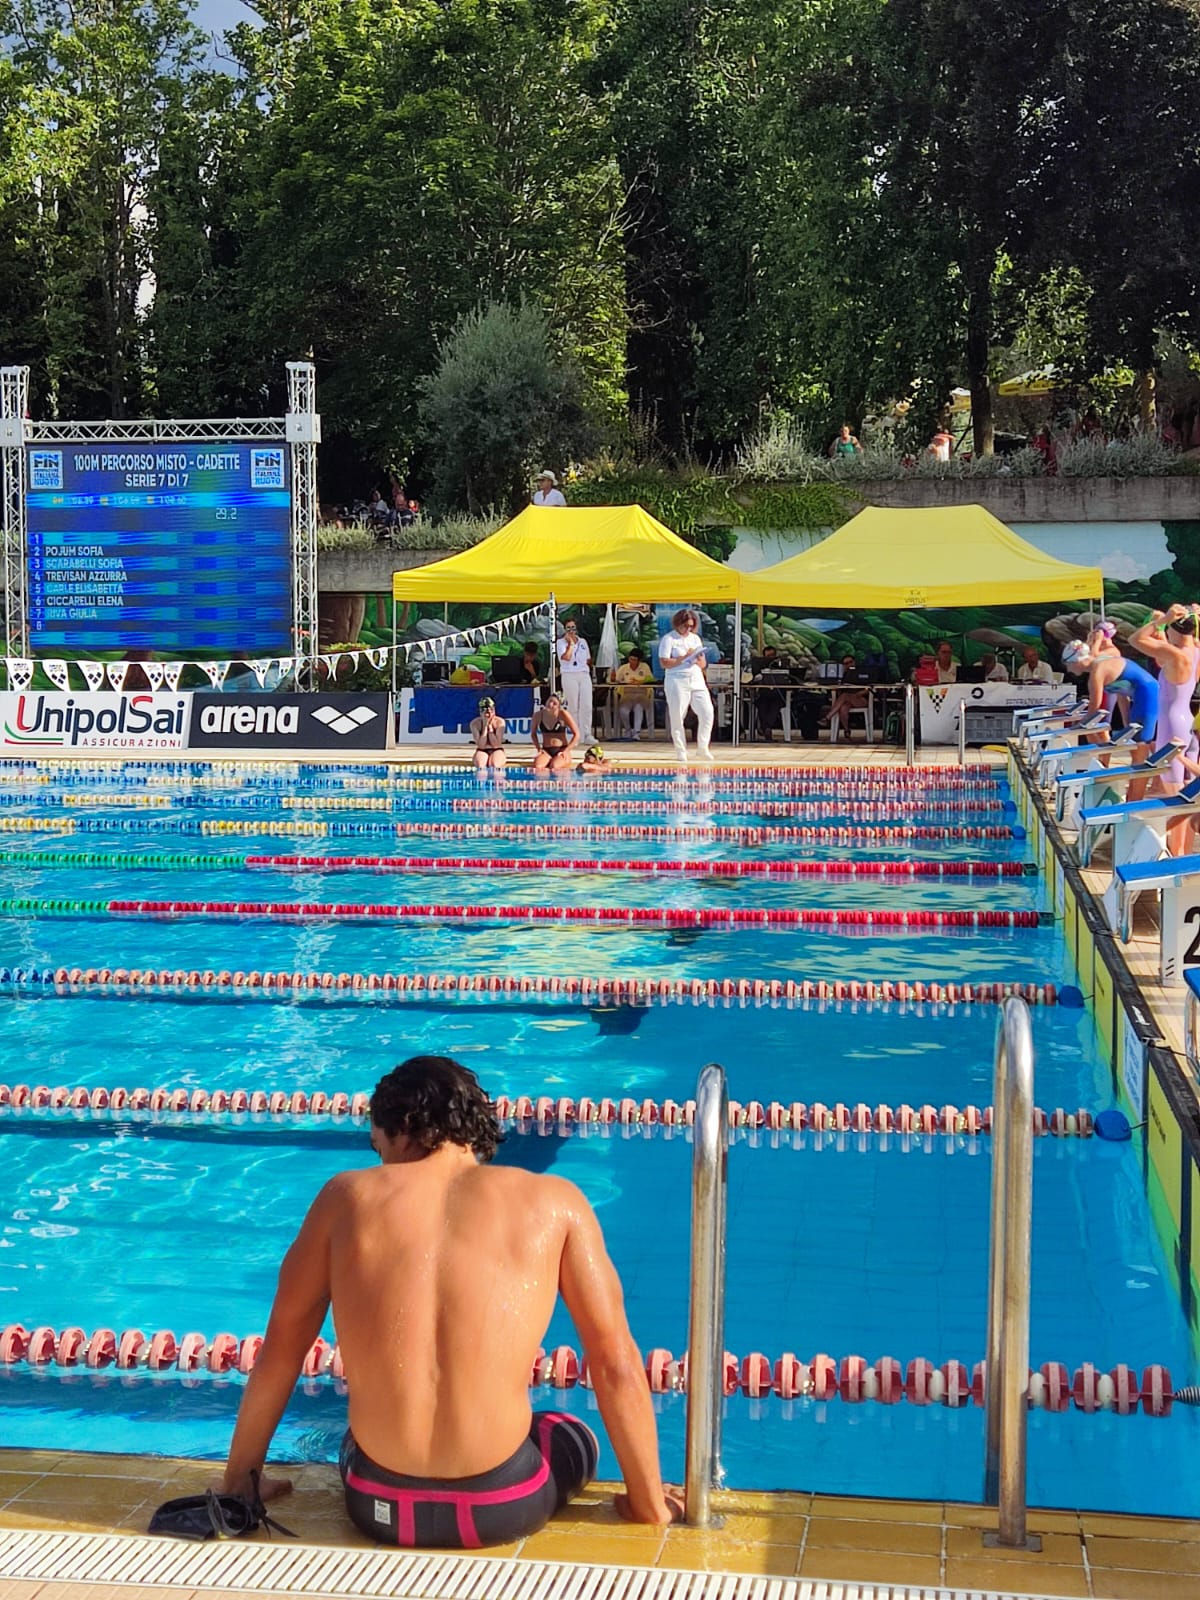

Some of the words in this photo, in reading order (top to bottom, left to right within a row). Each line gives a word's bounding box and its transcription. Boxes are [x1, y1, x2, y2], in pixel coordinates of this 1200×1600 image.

[33, 453, 59, 468] FIN
[74, 454, 99, 471] 100M
[101, 454, 154, 471] PERCORSO
[156, 453, 187, 471] MISTO
[196, 453, 241, 470] CADETTE
[255, 452, 281, 467] FIN
[125, 473, 156, 487] SERIE
[158, 473, 165, 487] 7
[167, 473, 180, 487] DI
[182, 473, 190, 487] 7
[215, 507, 238, 520] 29.2
[34, 547, 40, 556] 2
[45, 546, 76, 557] POJUM
[77, 546, 104, 557] SOFIA
[34, 560, 40, 569] 3
[45, 558, 96, 570] SCARABELLI
[98, 558, 124, 570] SOFIA
[34, 572, 41, 582] 4
[46, 571, 87, 582] TREVISAN
[88, 571, 128, 582] AZZURRA
[35, 584, 41, 594] 5
[75, 584, 124, 594] ELISABETTA
[35, 597, 41, 606] 6
[46, 596, 96, 606] CICCARELLI
[97, 596, 124, 606] ELENA
[35, 609, 41, 619] 7
[68, 608, 97, 618] GIULIA
[36, 621, 42, 631] 8
[16, 695, 185, 746] UnipolSai
[199, 704, 300, 735] arena
[82, 737, 182, 748] ASSICURAZIONI
